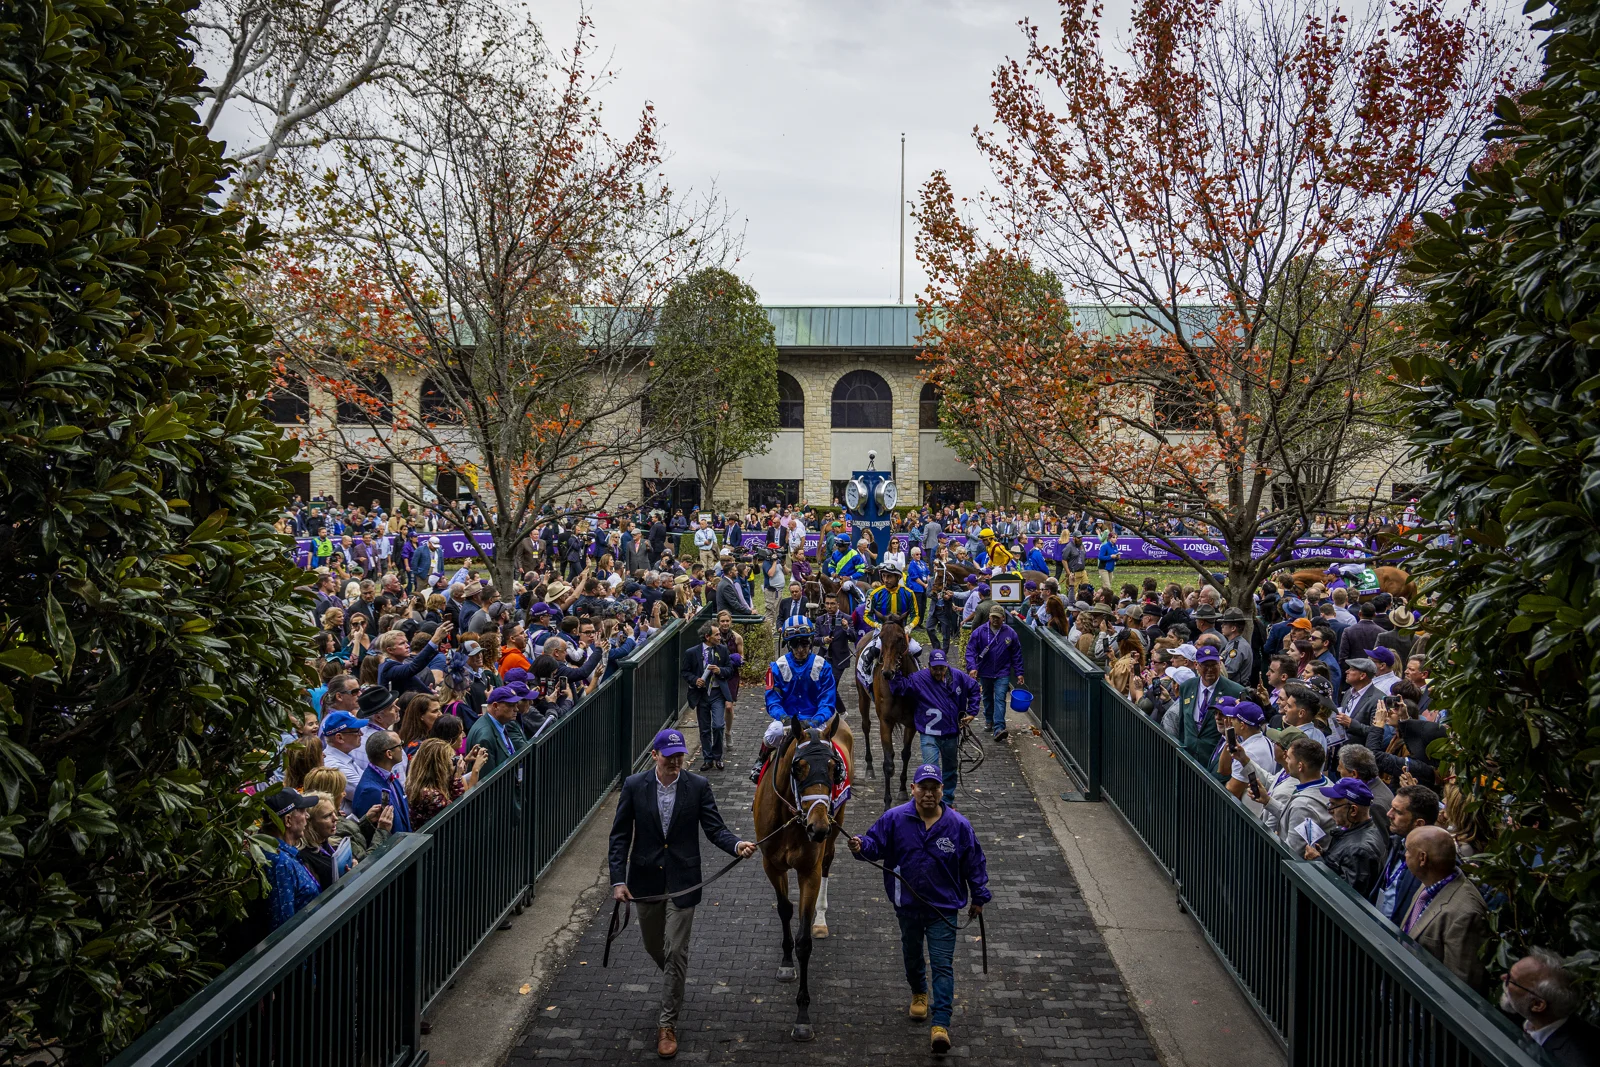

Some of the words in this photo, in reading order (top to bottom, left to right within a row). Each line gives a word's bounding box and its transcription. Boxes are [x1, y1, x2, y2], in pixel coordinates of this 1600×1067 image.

[1094, 544, 1132, 552] FUEL
[1183, 543, 1230, 552] LONGIN
[1310, 548, 1332, 556] FANS
[1362, 568, 1376, 583] 5
[866, 599, 871, 609] 2
[925, 708, 943, 736] 2
